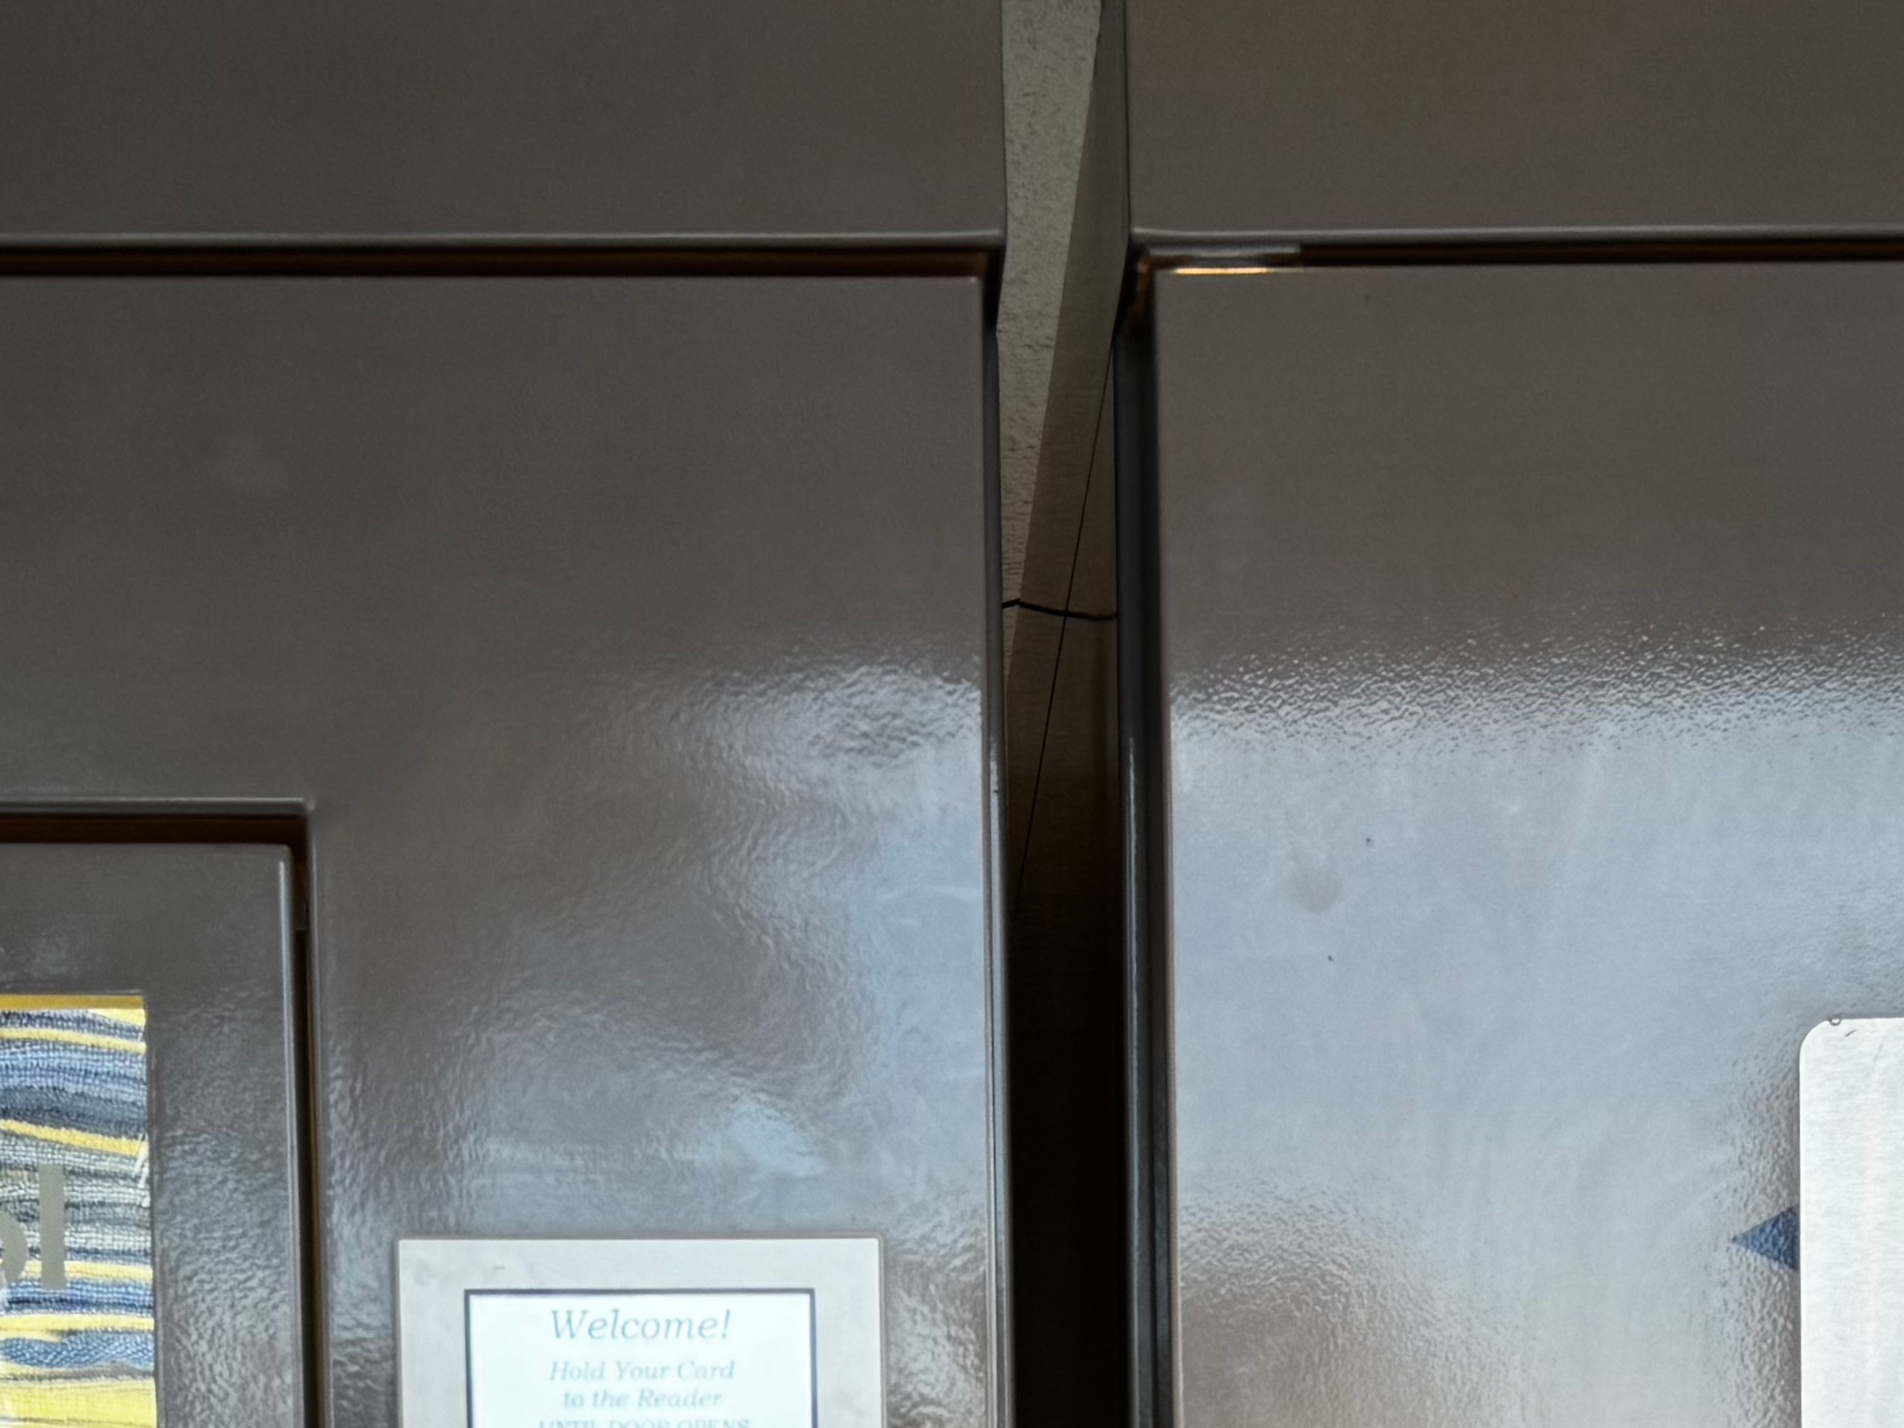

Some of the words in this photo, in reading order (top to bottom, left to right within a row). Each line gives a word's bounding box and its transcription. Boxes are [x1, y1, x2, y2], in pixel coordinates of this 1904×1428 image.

[551, 1308, 731, 1340] Welcome!
[549, 1360, 606, 1381] Hold
[614, 1360, 671, 1381] Your
[677, 1358, 737, 1380] Card
[563, 1390, 586, 1409] to
[592, 1388, 630, 1409] the
[637, 1387, 724, 1409] Reader
